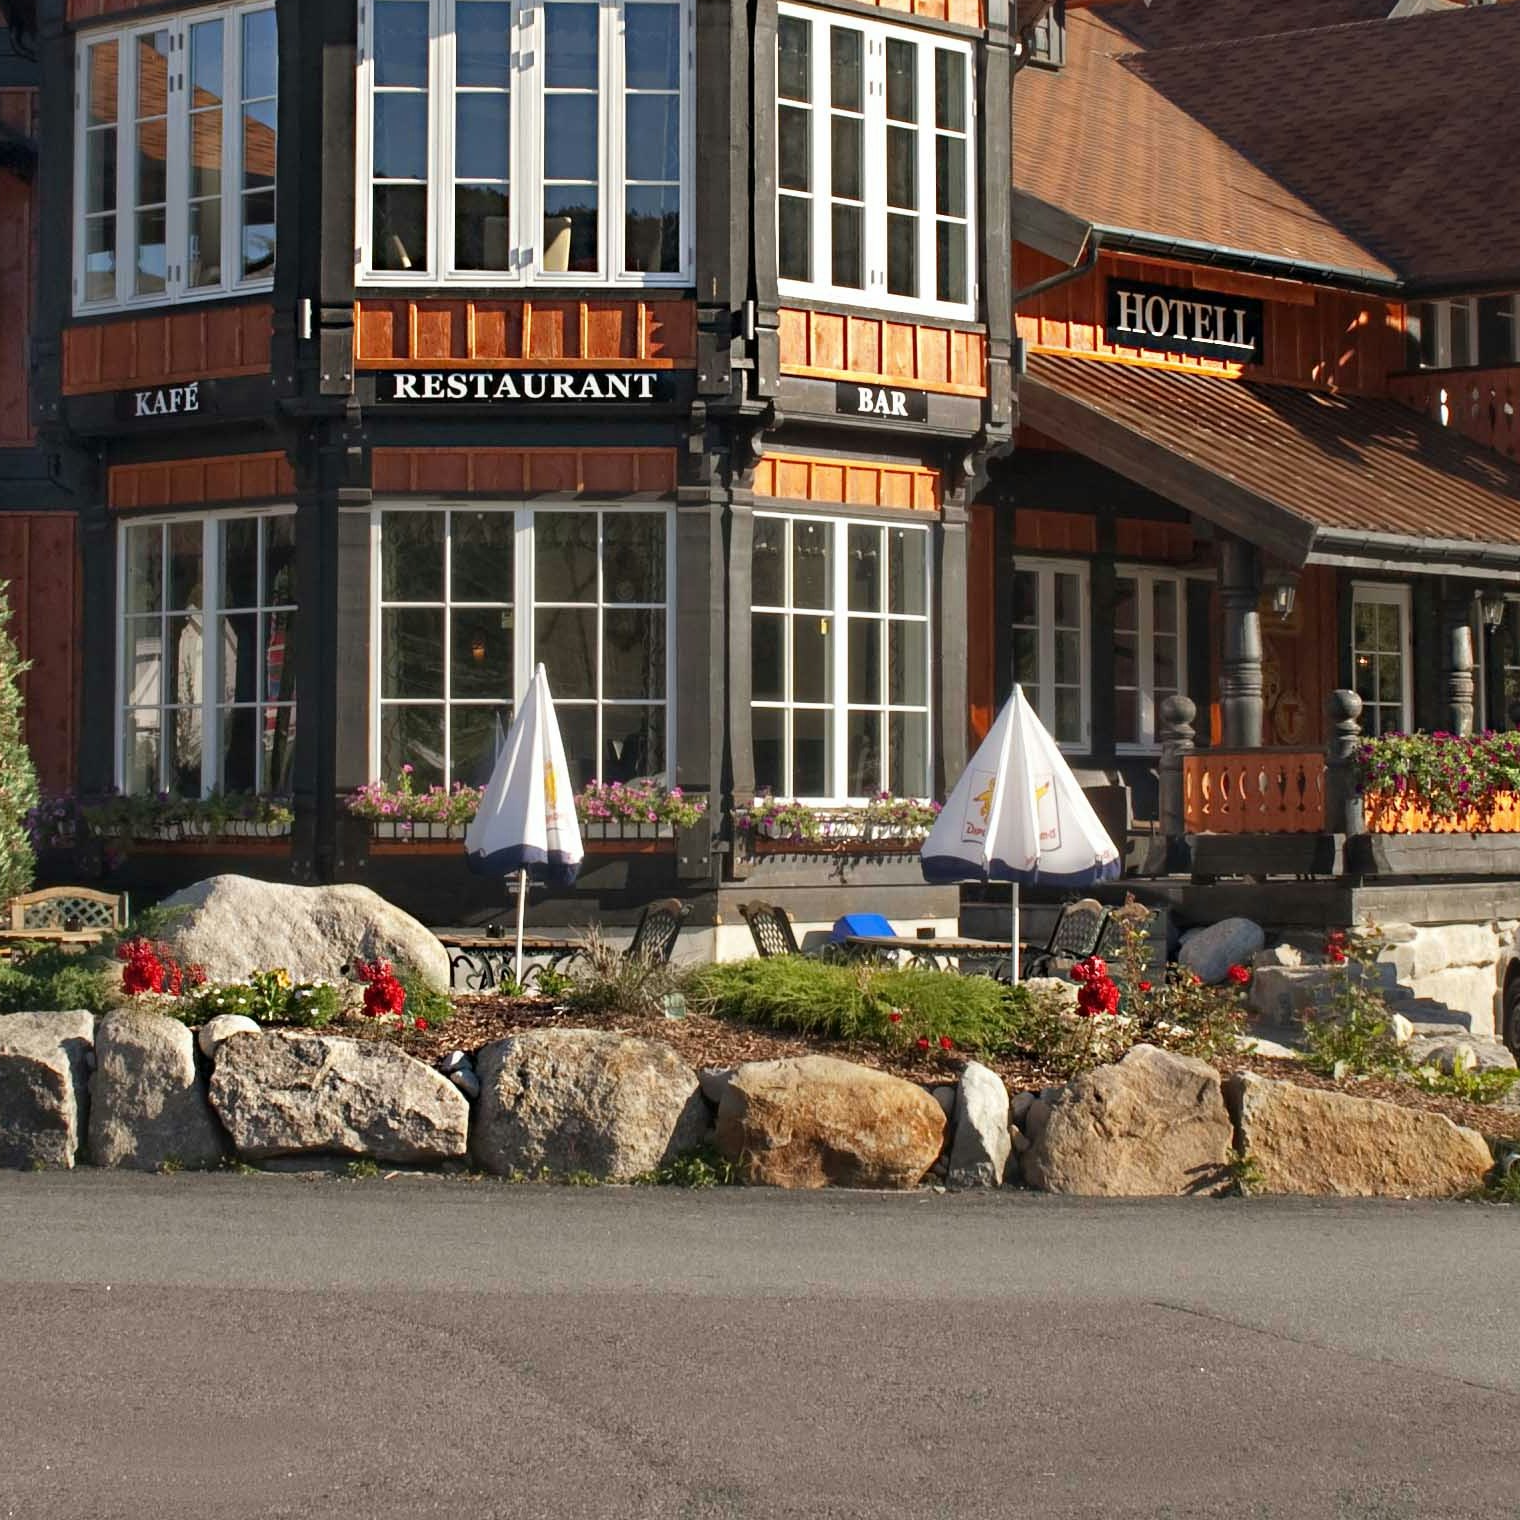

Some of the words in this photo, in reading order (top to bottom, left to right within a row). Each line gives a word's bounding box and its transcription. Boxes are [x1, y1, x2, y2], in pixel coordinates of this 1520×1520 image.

[1116, 291, 1256, 350] HOTELL
[134, 381, 199, 416] KAFÉ
[393, 373, 658, 399] RESTAURANT
[857, 386, 909, 416] BAR
